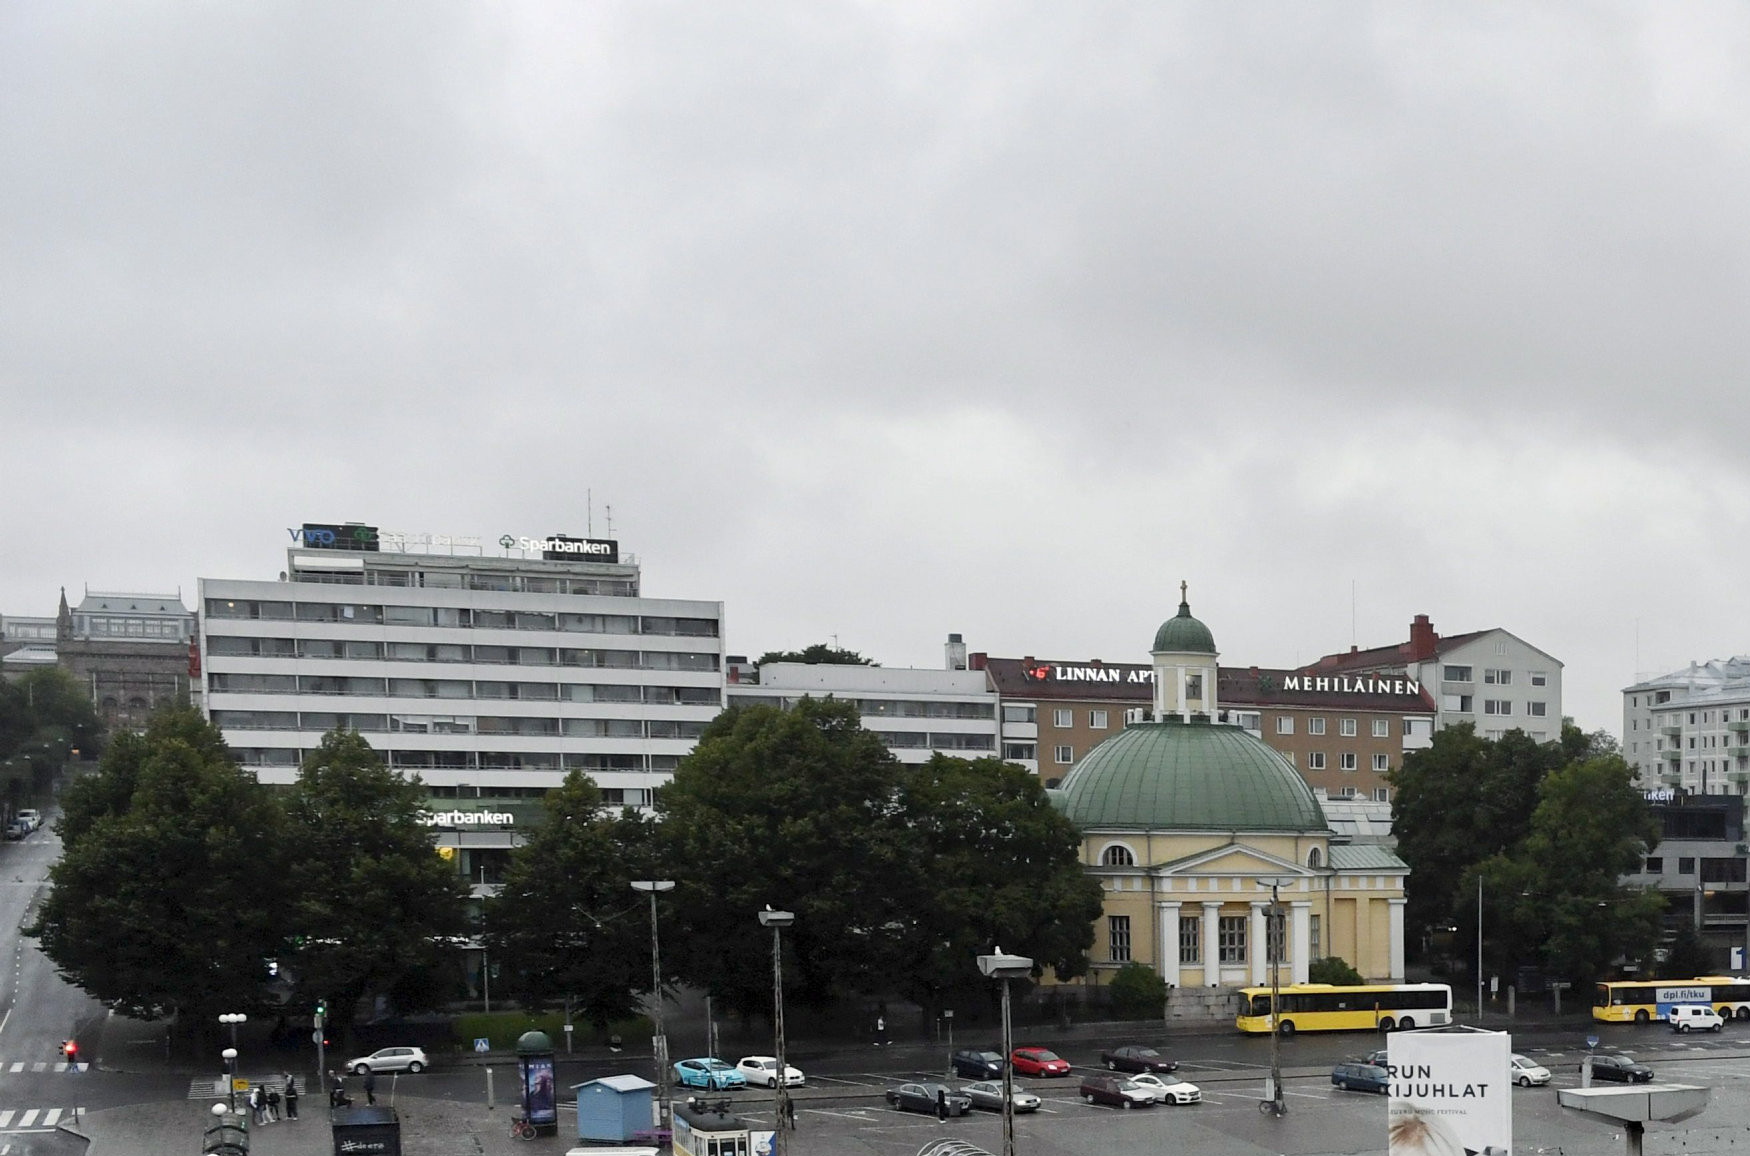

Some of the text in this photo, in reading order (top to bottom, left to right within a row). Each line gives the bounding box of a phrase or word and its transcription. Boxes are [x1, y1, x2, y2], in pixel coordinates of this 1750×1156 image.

[519, 536, 610, 555] Sparbanken
[1055, 666, 1120, 682] LINNAN
[1283, 676, 1420, 695] MEHILÄINEN
[415, 808, 514, 827] Sparbanken
[1662, 988, 1705, 1000] dpl.fi/tku
